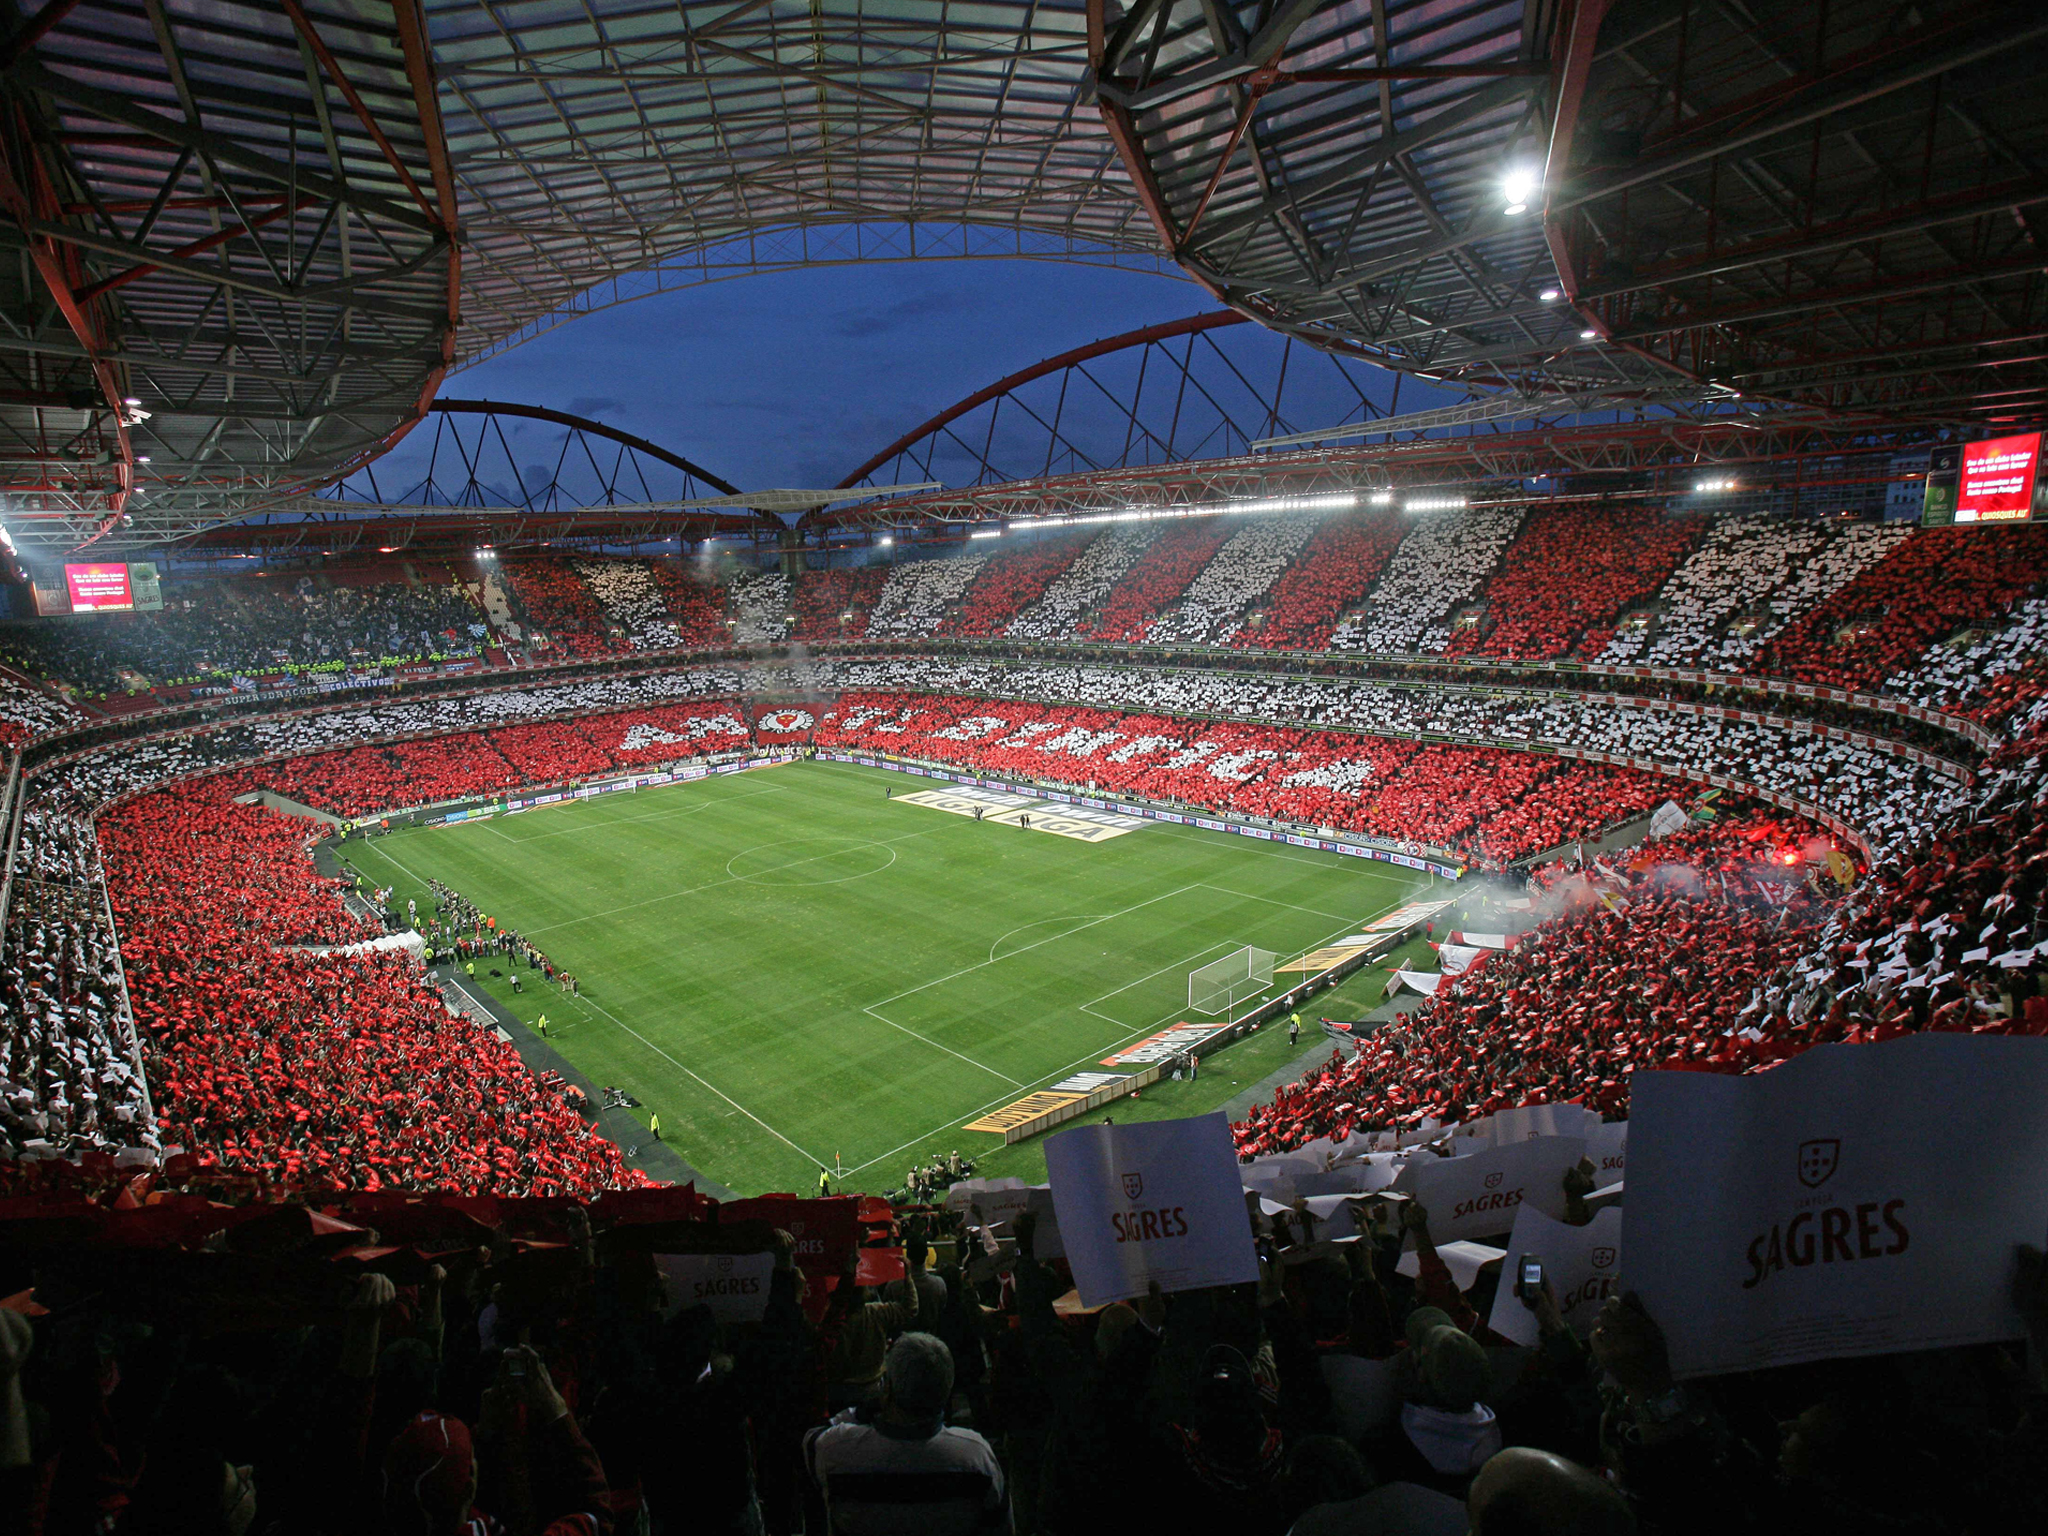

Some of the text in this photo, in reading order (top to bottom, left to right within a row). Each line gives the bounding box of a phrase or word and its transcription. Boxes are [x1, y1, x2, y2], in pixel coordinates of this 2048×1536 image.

[137, 596, 159, 605] SAGRES
[225, 694, 259, 705] SUPER
[907, 794, 986, 816] LIGA
[939, 786, 1030, 806] bwin
[1006, 812, 1101, 838] LIGA
[1035, 804, 1142, 828] bwin
[1452, 1188, 1524, 1220] SAGRES
[1112, 1207, 1188, 1242] SAGRES
[1742, 1200, 1910, 1289] SAGRES
[694, 1277, 760, 1297] SAGRES
